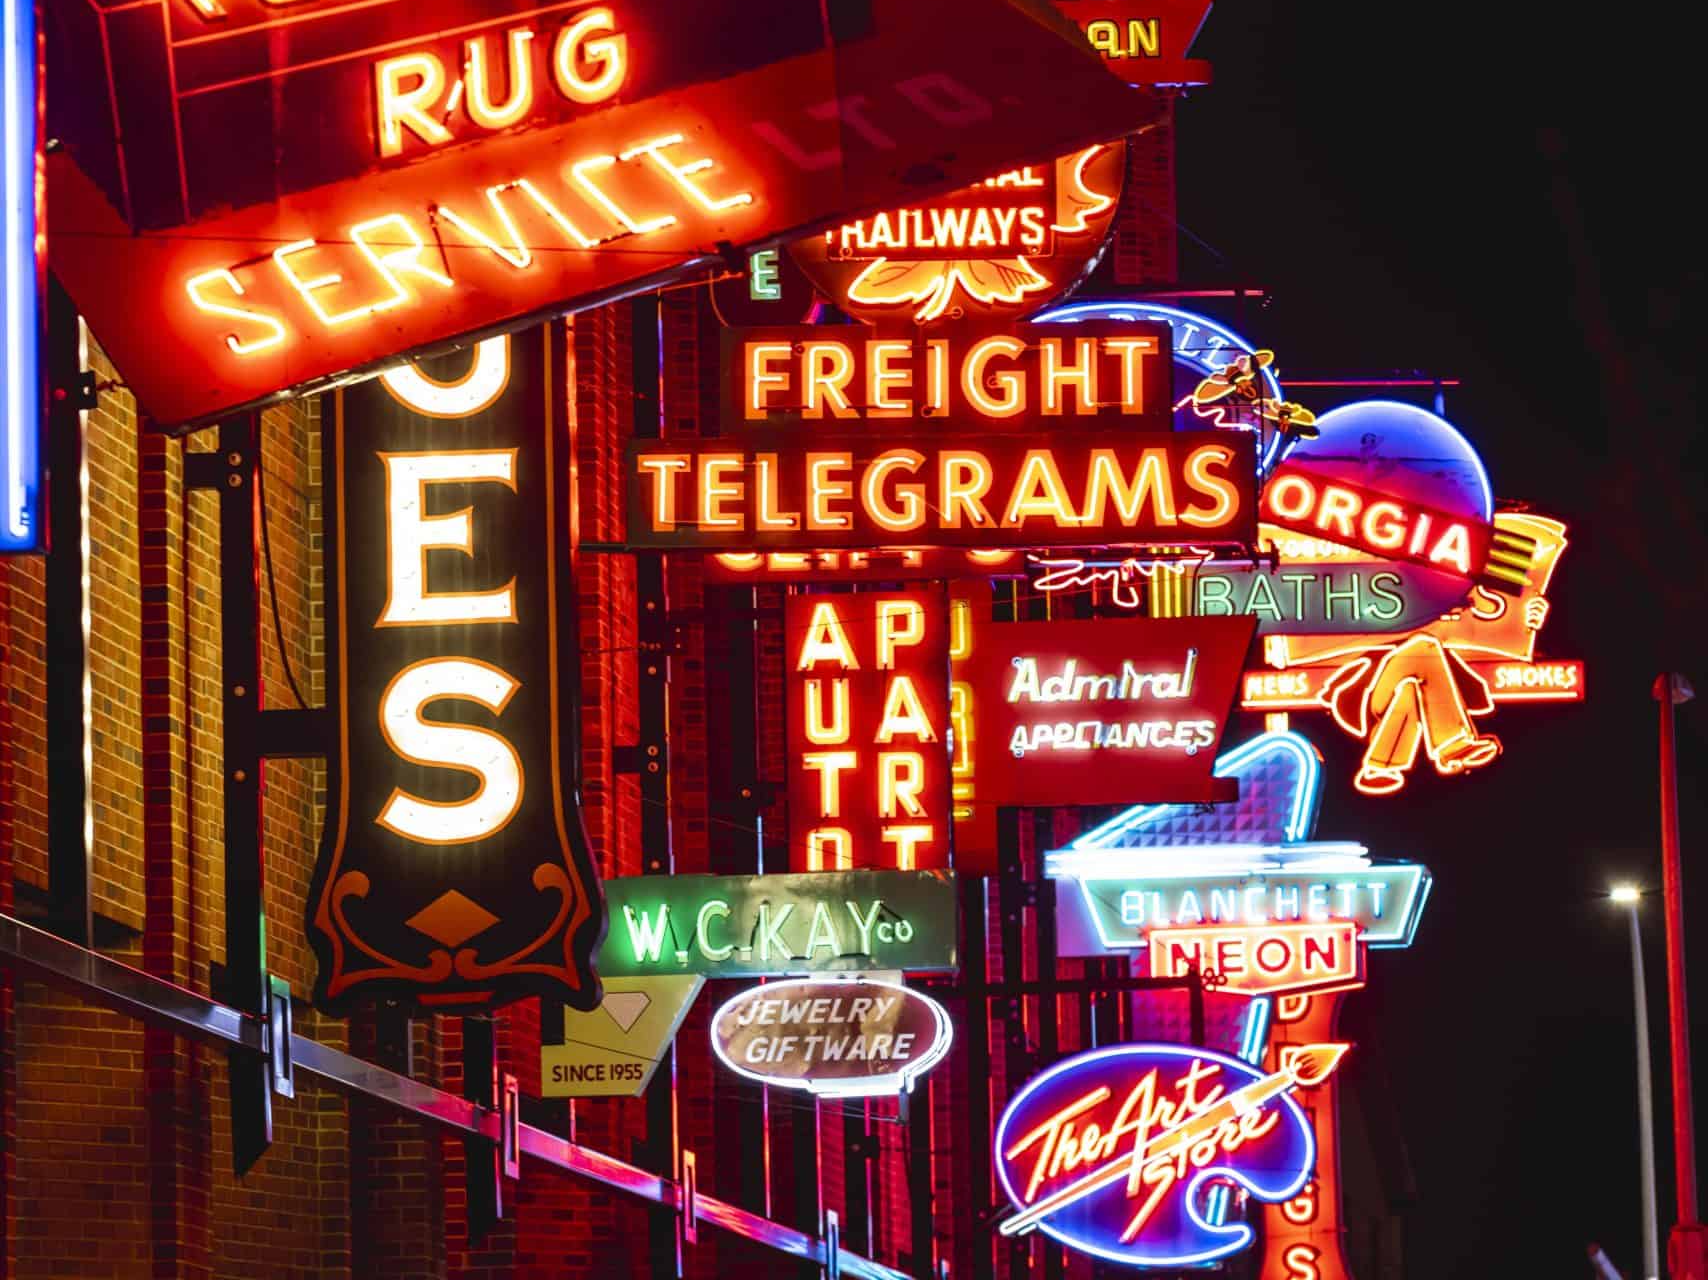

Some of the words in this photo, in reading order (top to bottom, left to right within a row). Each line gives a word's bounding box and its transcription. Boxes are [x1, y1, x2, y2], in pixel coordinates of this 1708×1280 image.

[374, 7, 628, 160] RUG
[185, 133, 754, 356] SERVICE
[745, 336, 1159, 420] FREIGHT
[637, 445, 1241, 533] TELEGRAMS
[1198, 573, 1405, 620] BATHS
[1007, 648, 1198, 702] Admiral
[1245, 673, 1309, 700] NEWS
[1495, 665, 1578, 689] SMOKES
[1009, 720, 1216, 752] APPLIANCES
[1120, 880, 1388, 926] BLANCHETT
[1170, 935, 1336, 976] NEON
[737, 997, 895, 1027] JEWELRY
[552, 1063, 606, 1082] SINCE
[609, 1062, 644, 1081] 1955
[1005, 1084, 1111, 1204] The
[1099, 1058, 1225, 1198] Art
